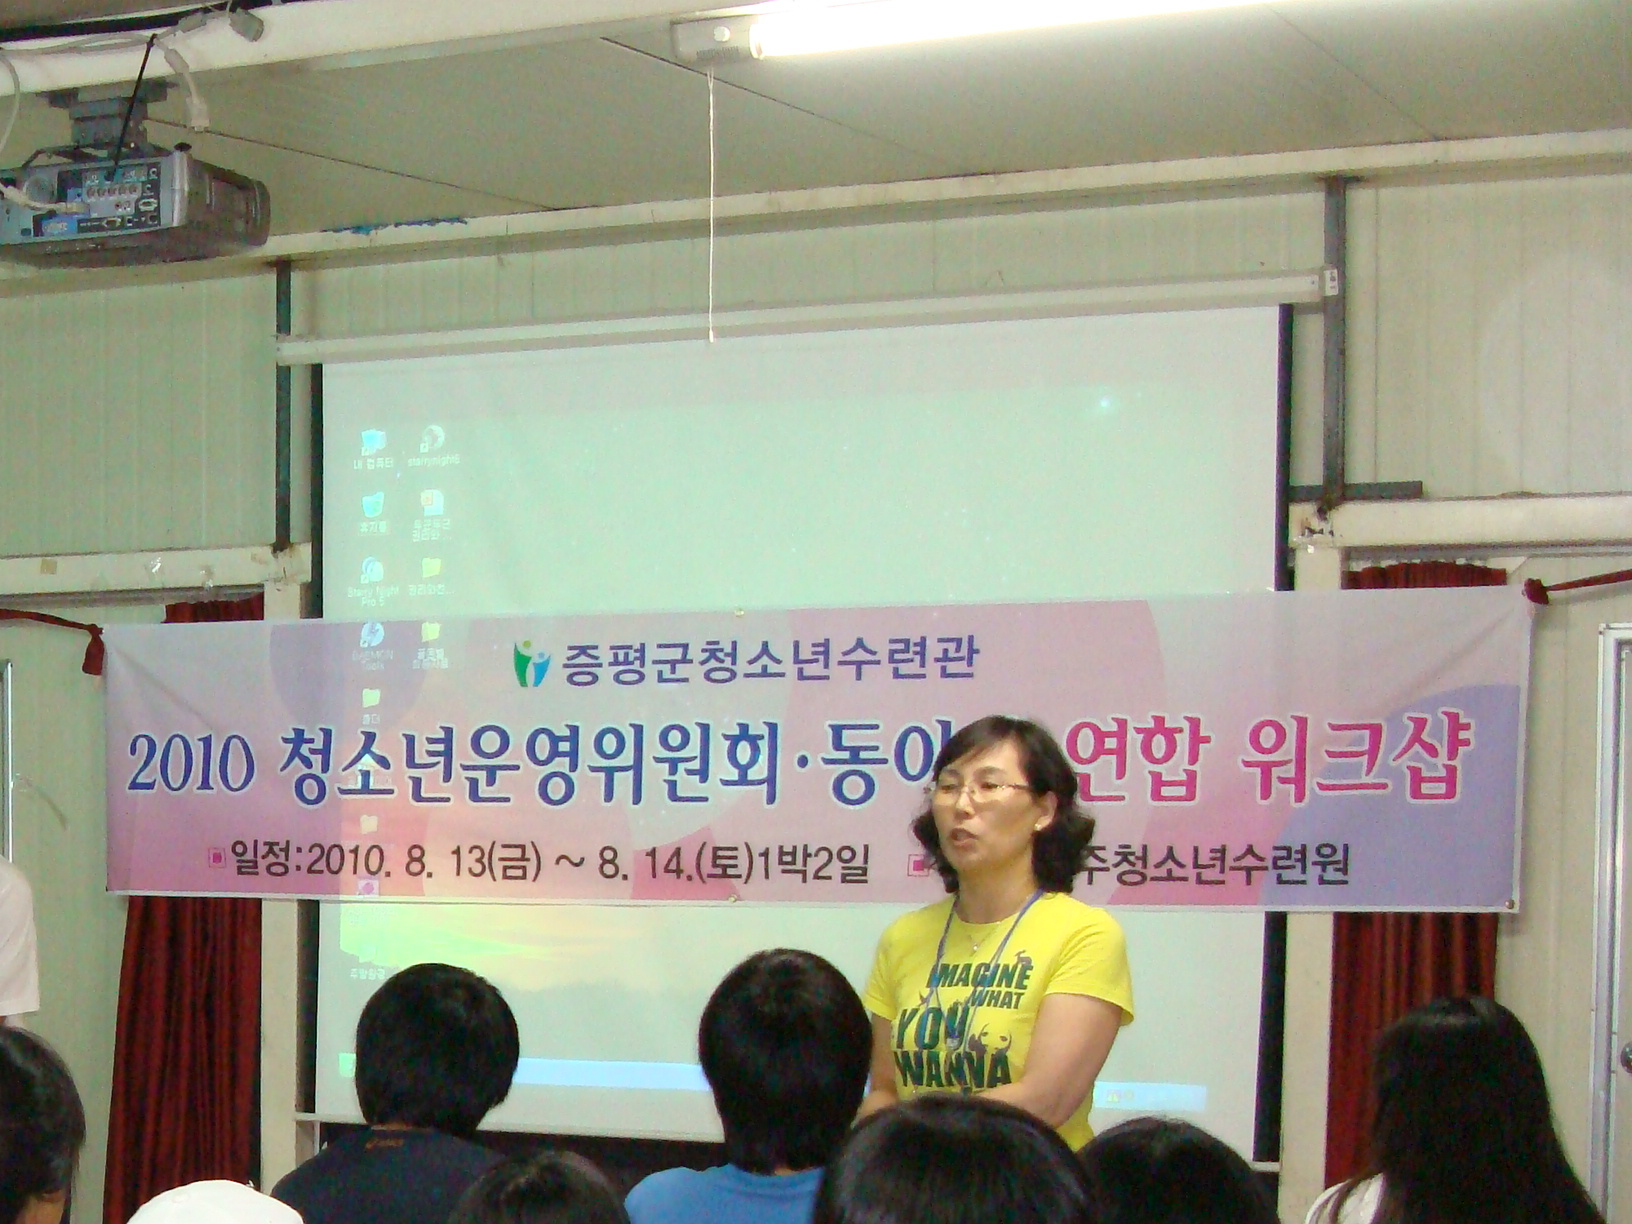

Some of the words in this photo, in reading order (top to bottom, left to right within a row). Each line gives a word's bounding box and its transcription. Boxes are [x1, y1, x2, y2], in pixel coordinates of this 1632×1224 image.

[562, 634, 980, 687] 증평군청소년수련관
[127, 732, 256, 795] 2010
[279, 717, 953, 807] 청소년운영위원회·동아
[1066, 713, 1212, 803] 연합
[1241, 709, 1473, 804] 워크샵
[231, 840, 391, 880] 일정:2010.
[405, 844, 434, 880] 8.
[450, 841, 542, 883] 13(금)
[598, 846, 630, 883] 8.
[1080, 842, 1351, 887] 주청소년수련원
[926, 962, 1034, 991] IMAGINE
[968, 989, 1025, 1010] WHAT
[896, 1000, 971, 1051] YOU
[894, 1050, 1012, 1089] WANNA
